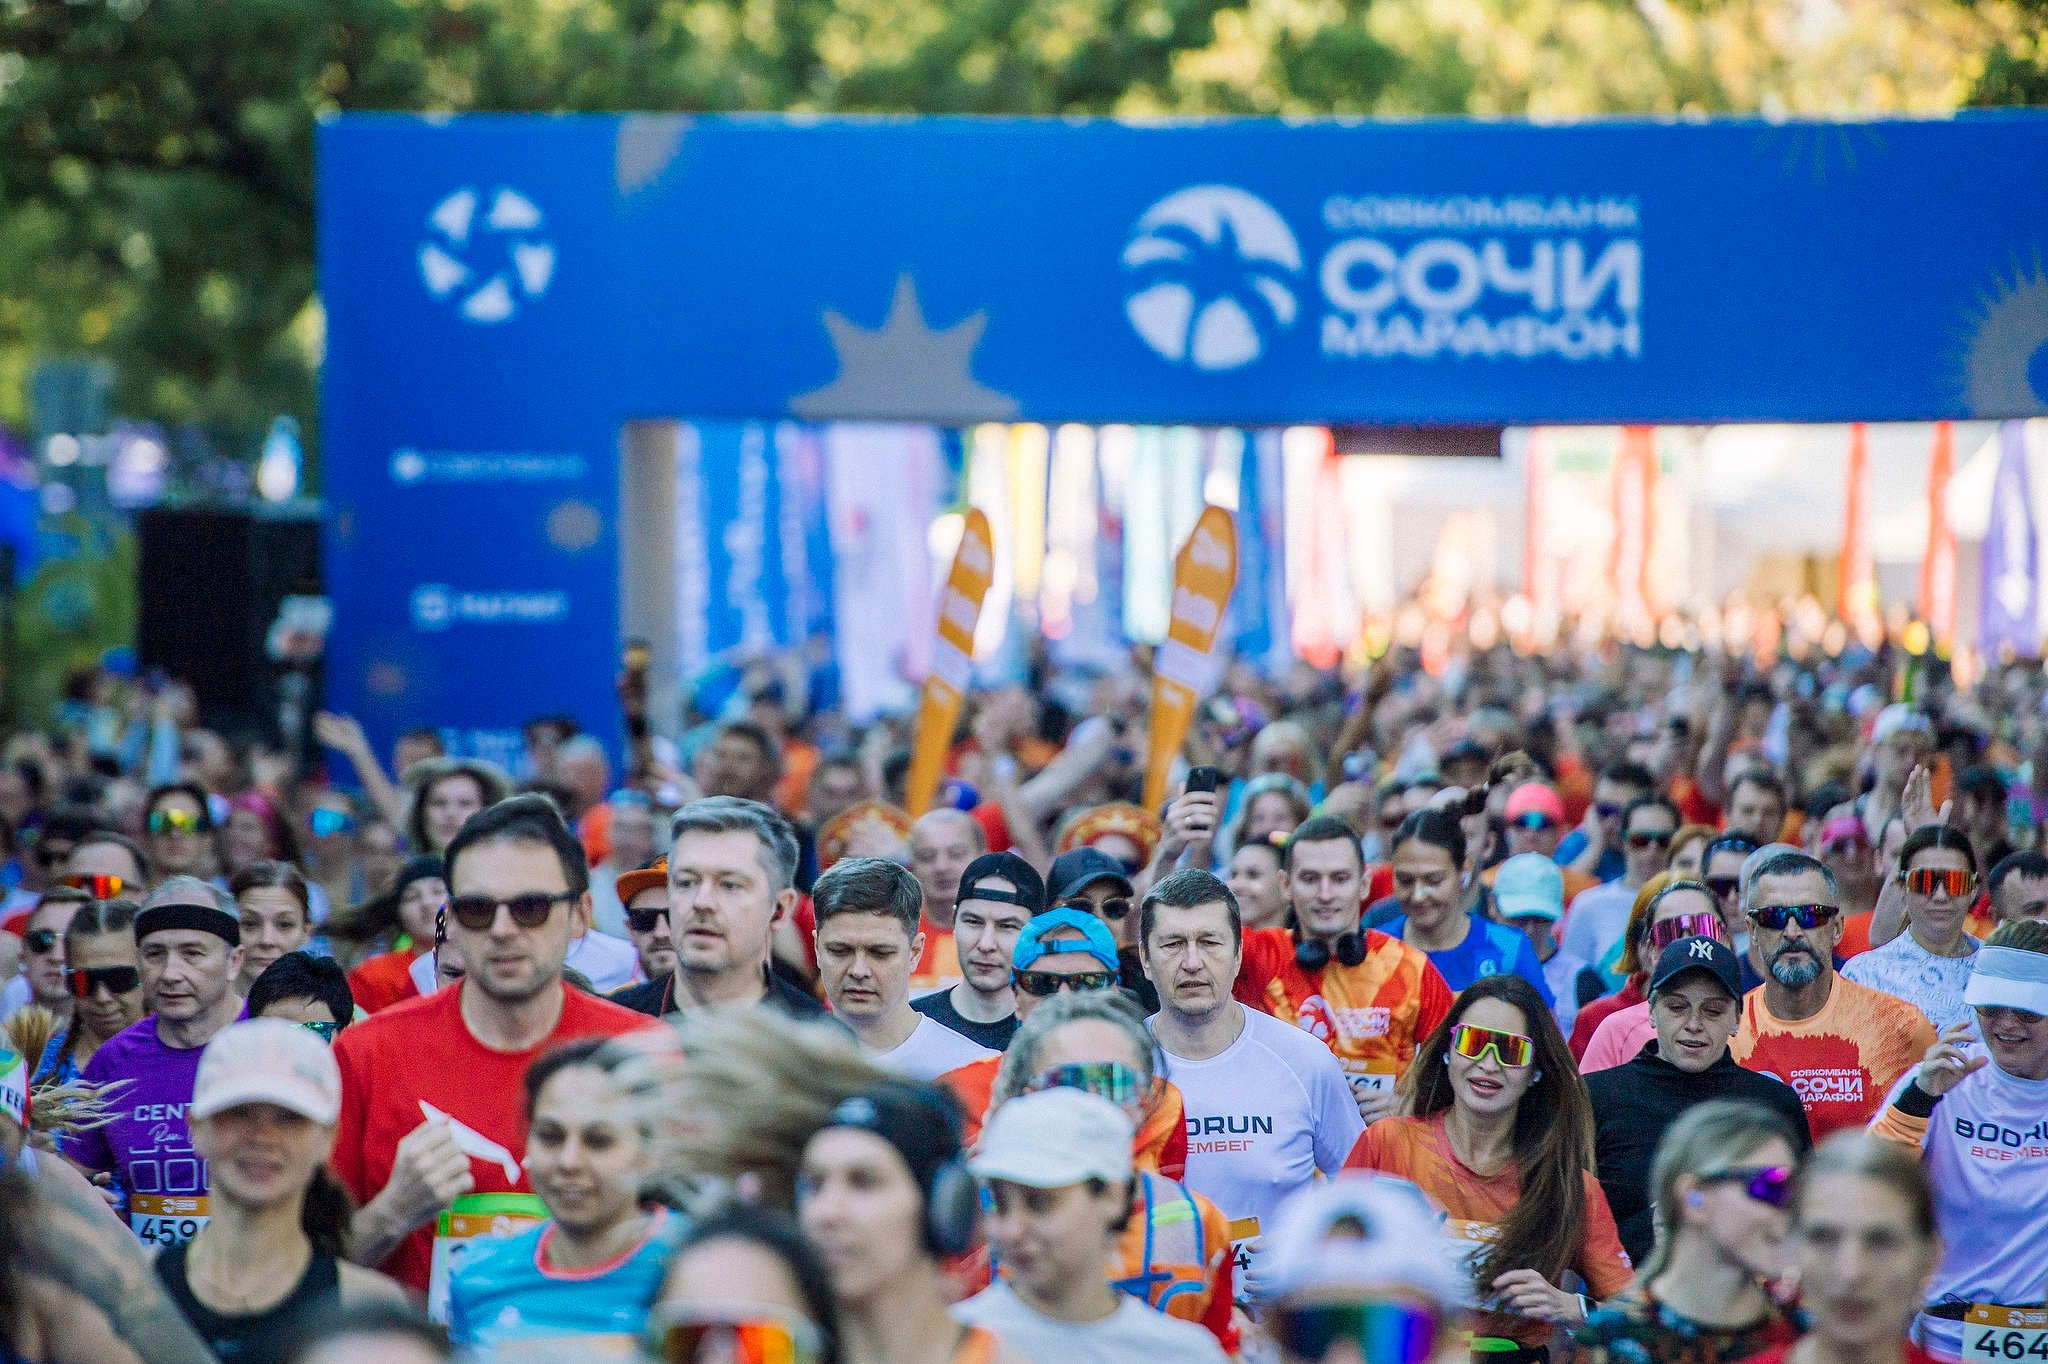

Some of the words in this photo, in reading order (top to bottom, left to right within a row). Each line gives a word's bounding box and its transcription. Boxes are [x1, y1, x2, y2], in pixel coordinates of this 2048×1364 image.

[1321, 237, 1641, 313] СОЧИ
[1321, 310, 1641, 359] МАРАФОН
[1790, 1068, 1862, 1078] СОВКОМБАНК
[1790, 1076, 1863, 1094] СОЧИ
[1185, 1115, 1273, 1136] ORUN
[1186, 1140, 1255, 1154] ЕМБЕГ
[141, 1217, 212, 1246] 459
[1974, 1328, 2048, 1360] 464
